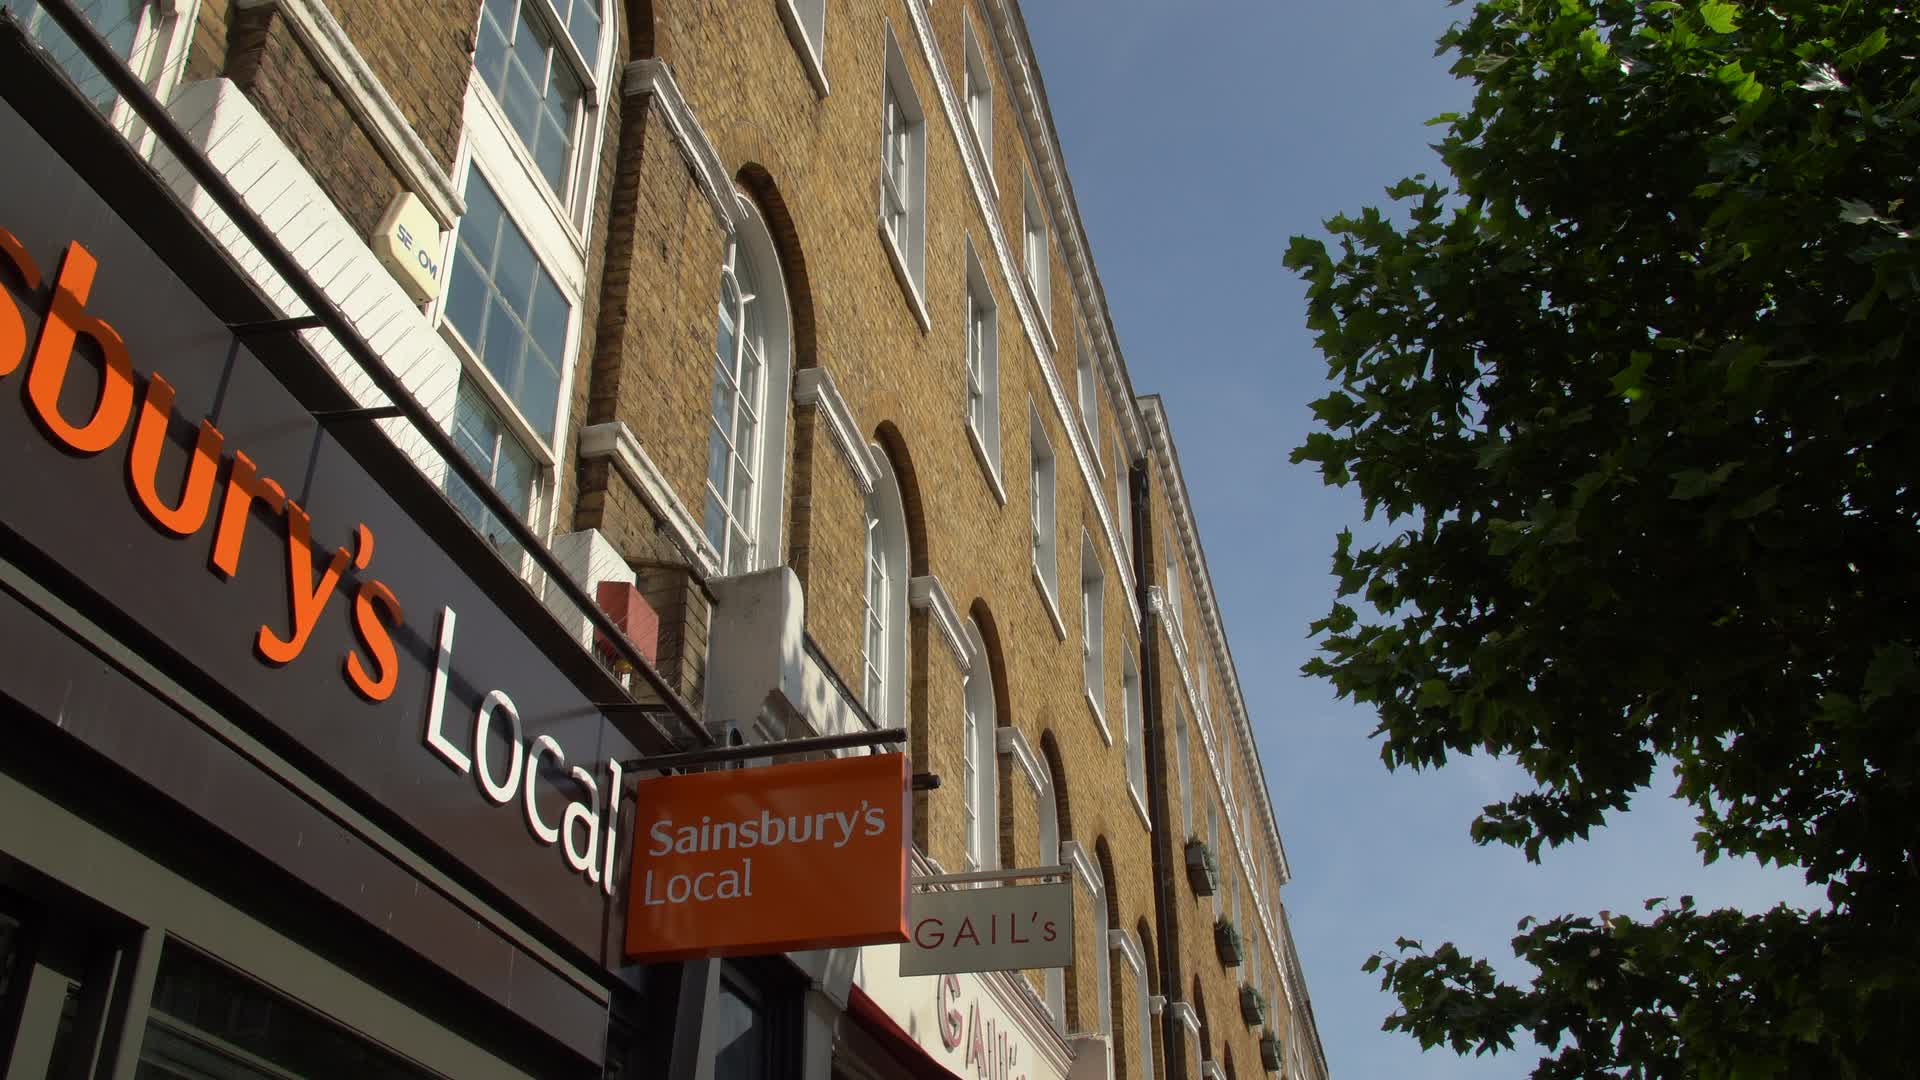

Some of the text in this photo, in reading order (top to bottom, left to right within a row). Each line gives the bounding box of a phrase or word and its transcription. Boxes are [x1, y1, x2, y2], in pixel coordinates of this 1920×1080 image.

[426, 605, 624, 895] Local
[649, 799, 886, 856] Sainsbury's
[644, 857, 752, 905] Local
[914, 911, 1057, 949] GAIL's
